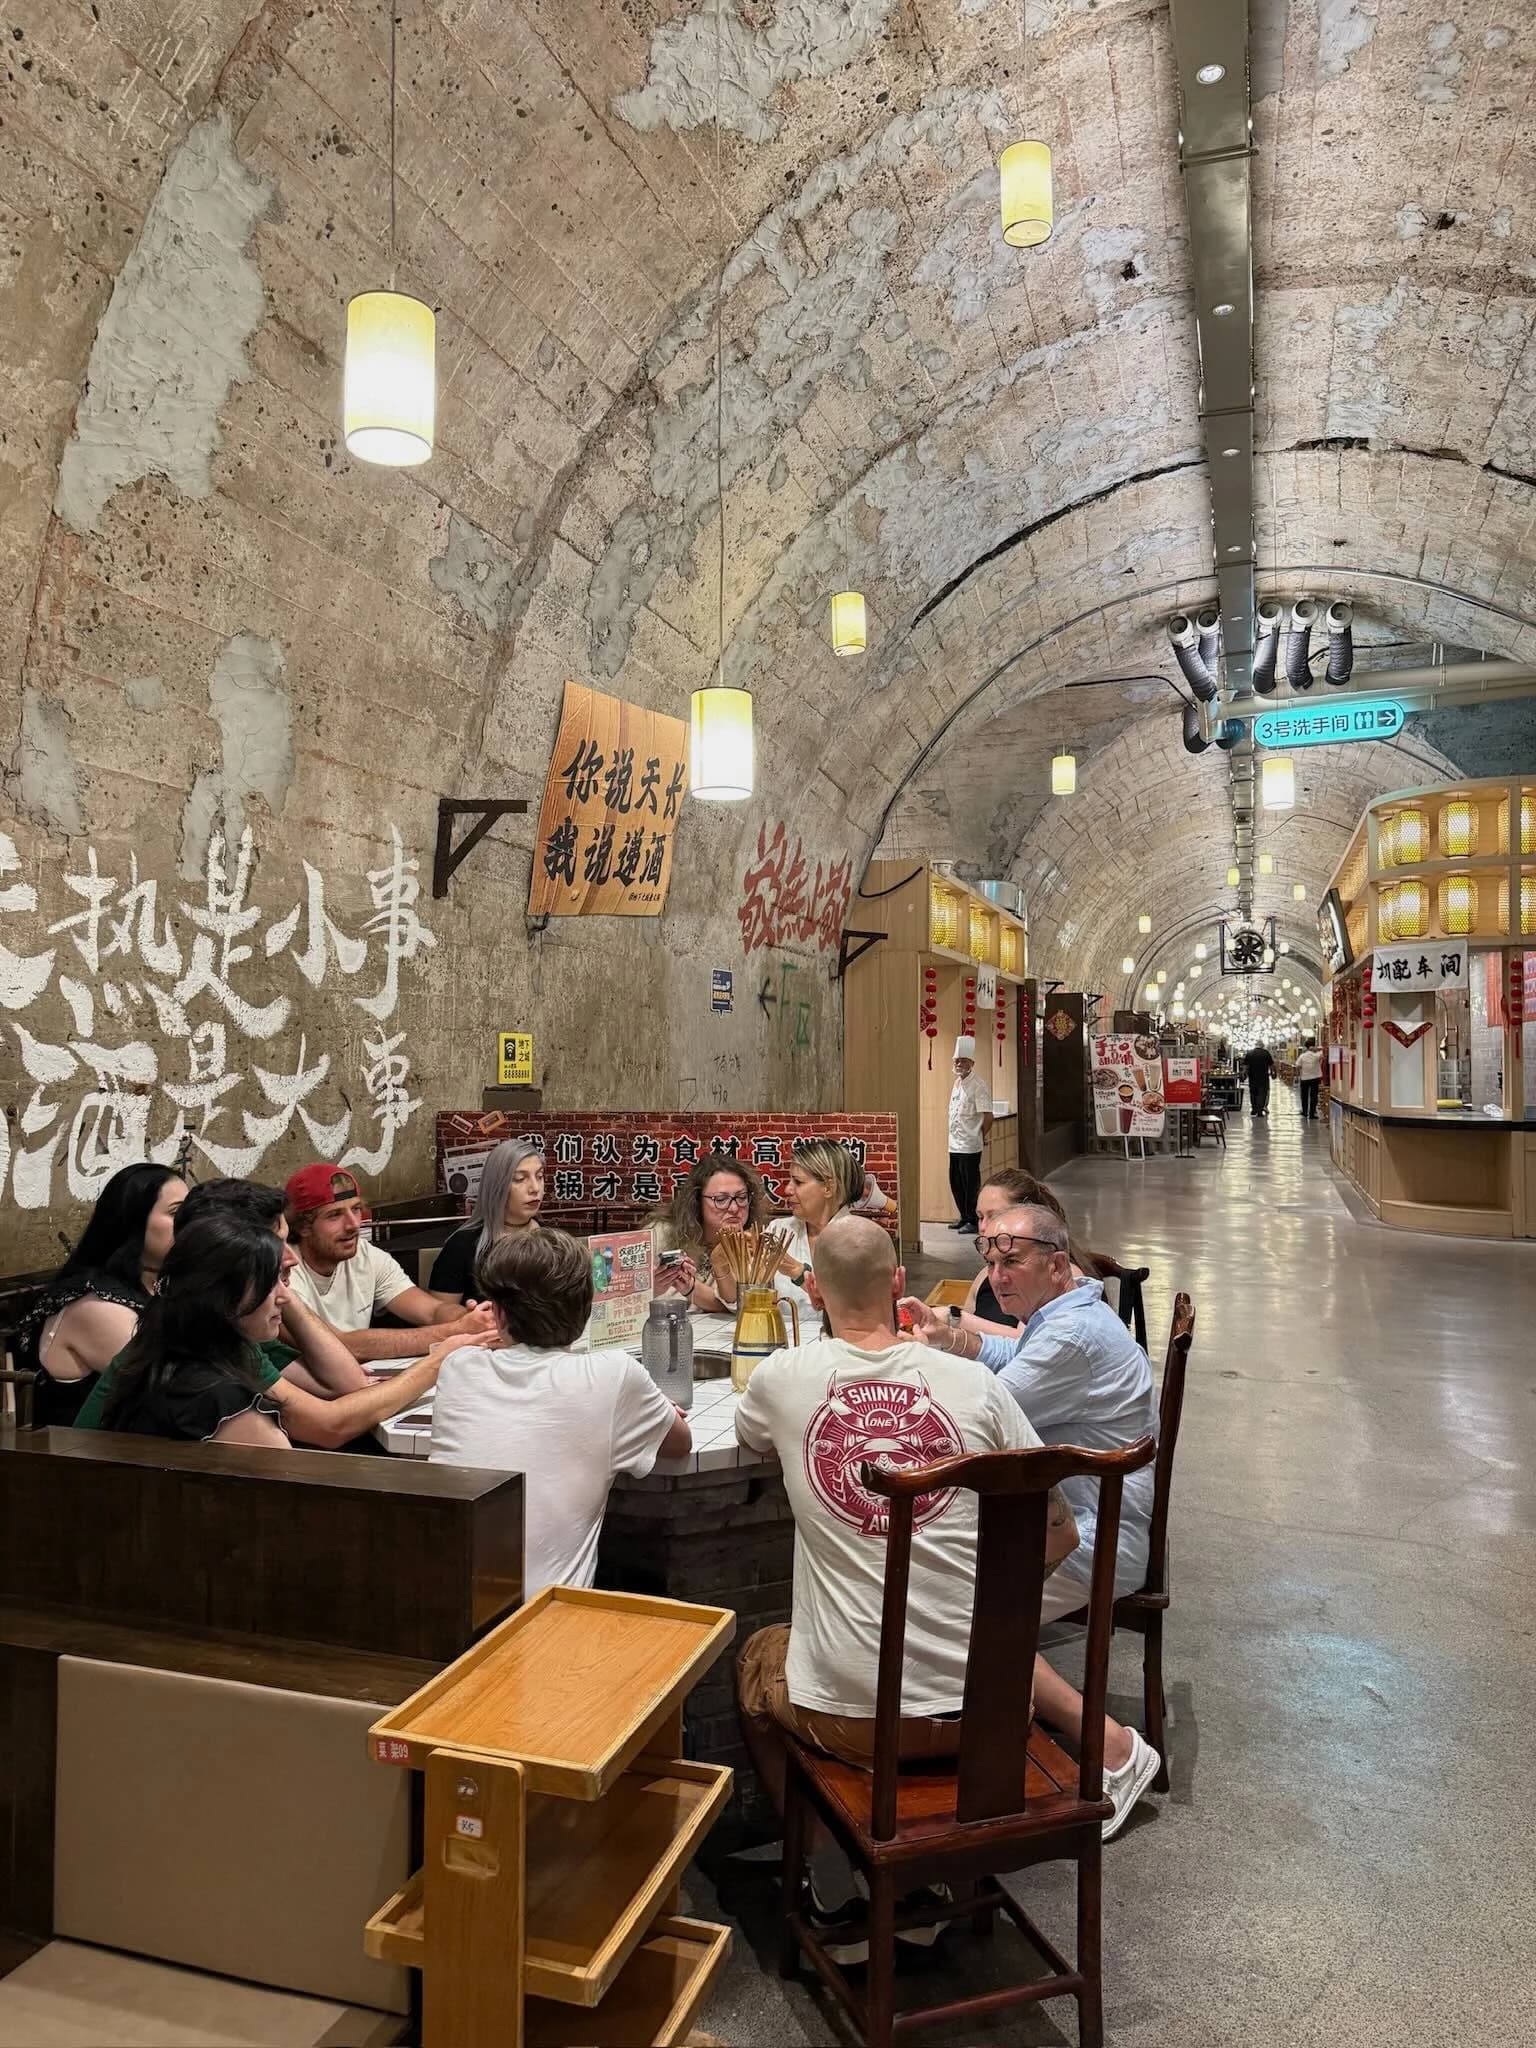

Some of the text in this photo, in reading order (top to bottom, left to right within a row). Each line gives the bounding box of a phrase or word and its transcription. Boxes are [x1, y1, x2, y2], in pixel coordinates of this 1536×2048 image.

[1261, 714, 1349, 739] 3号洗手间
[543, 815, 666, 887] 我说递酒
[0, 1020, 424, 1209] 酒是大事
[847, 1386, 908, 1406] SHINYA
[868, 1417, 895, 1428] ONE
